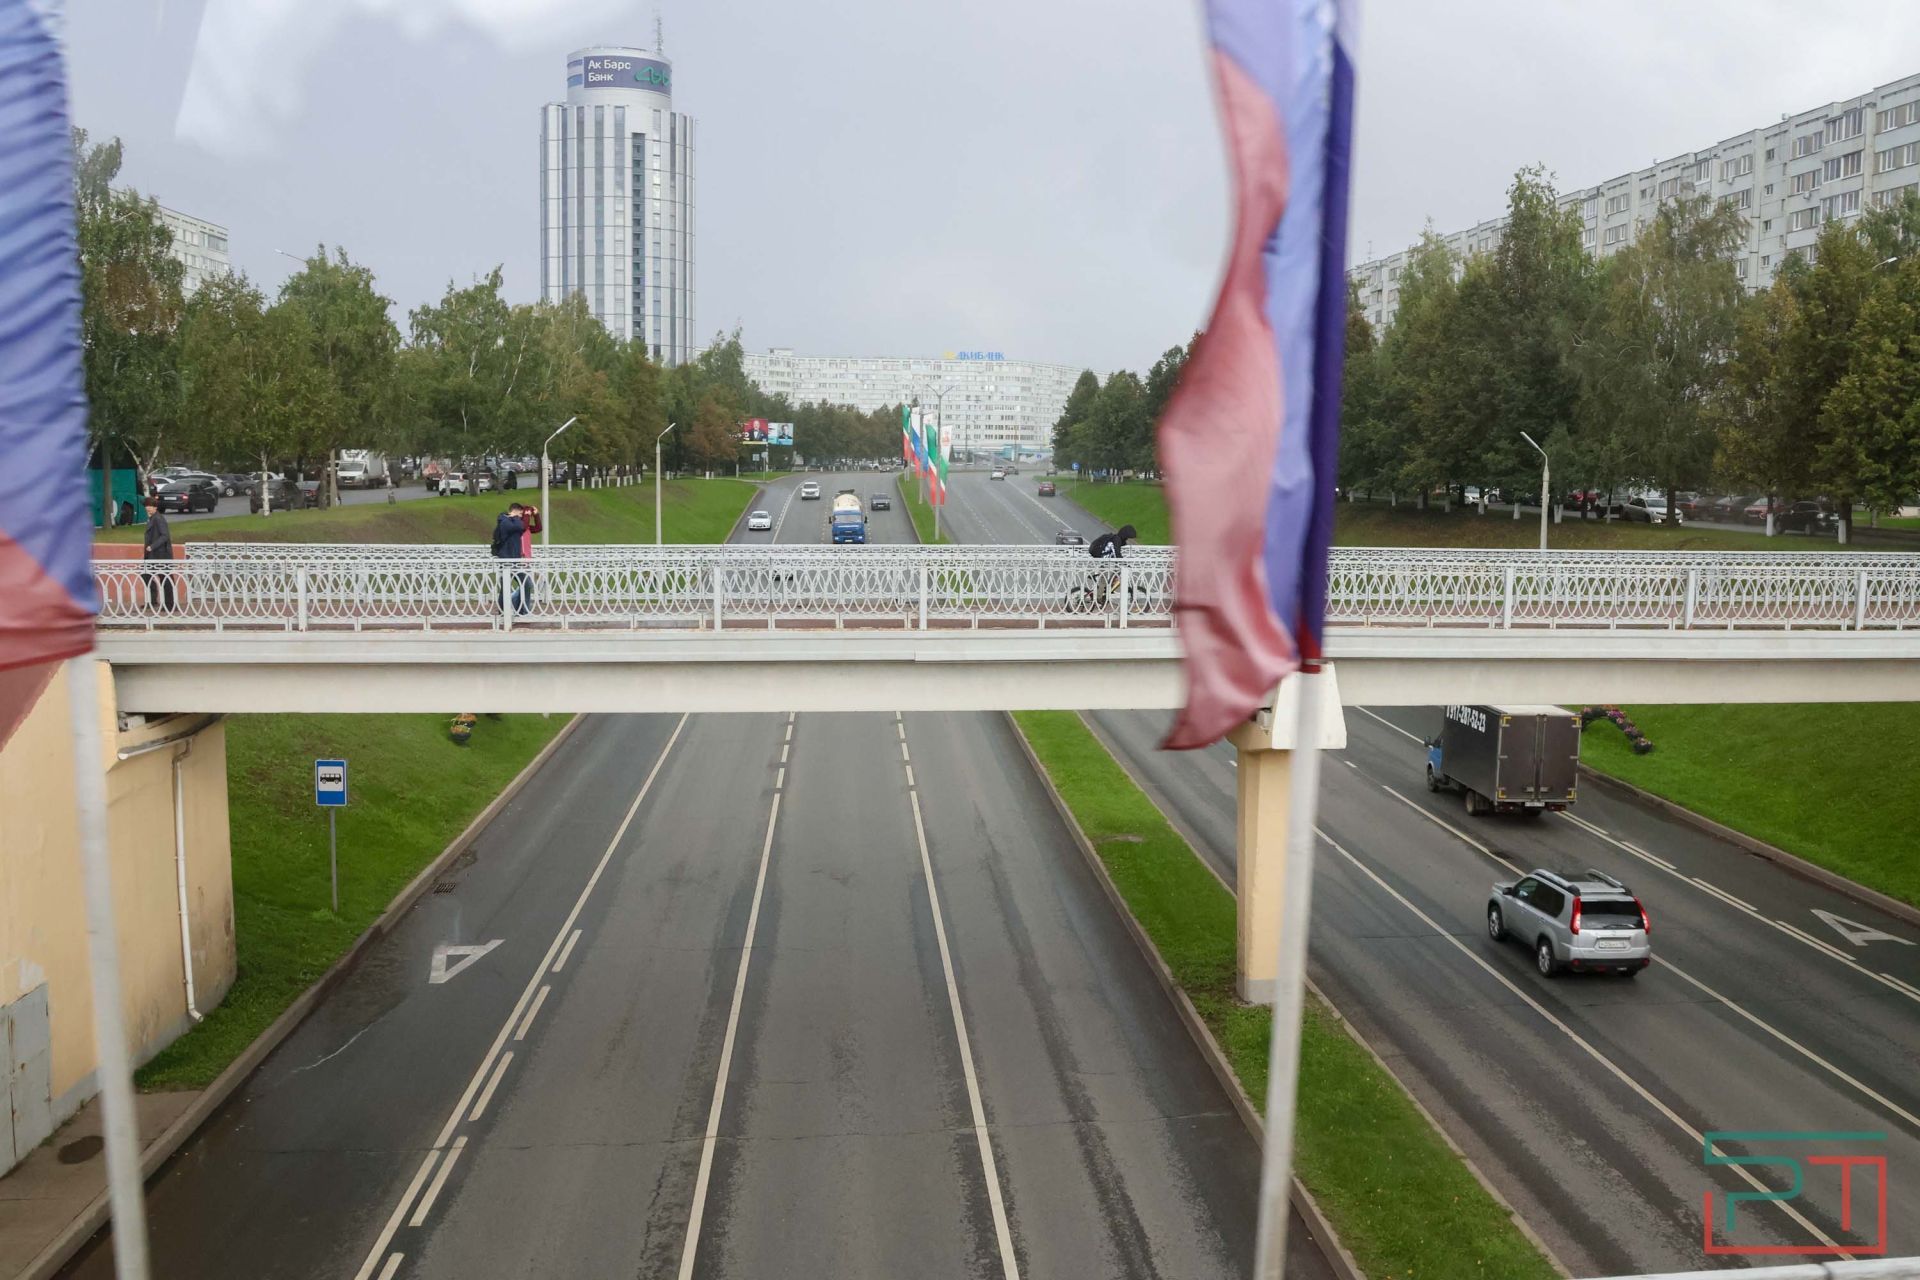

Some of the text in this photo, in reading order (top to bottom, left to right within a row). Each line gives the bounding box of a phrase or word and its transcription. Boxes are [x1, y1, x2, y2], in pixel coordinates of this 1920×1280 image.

[588, 59, 632, 72] Ак Барс
[588, 72, 614, 82] Банк
